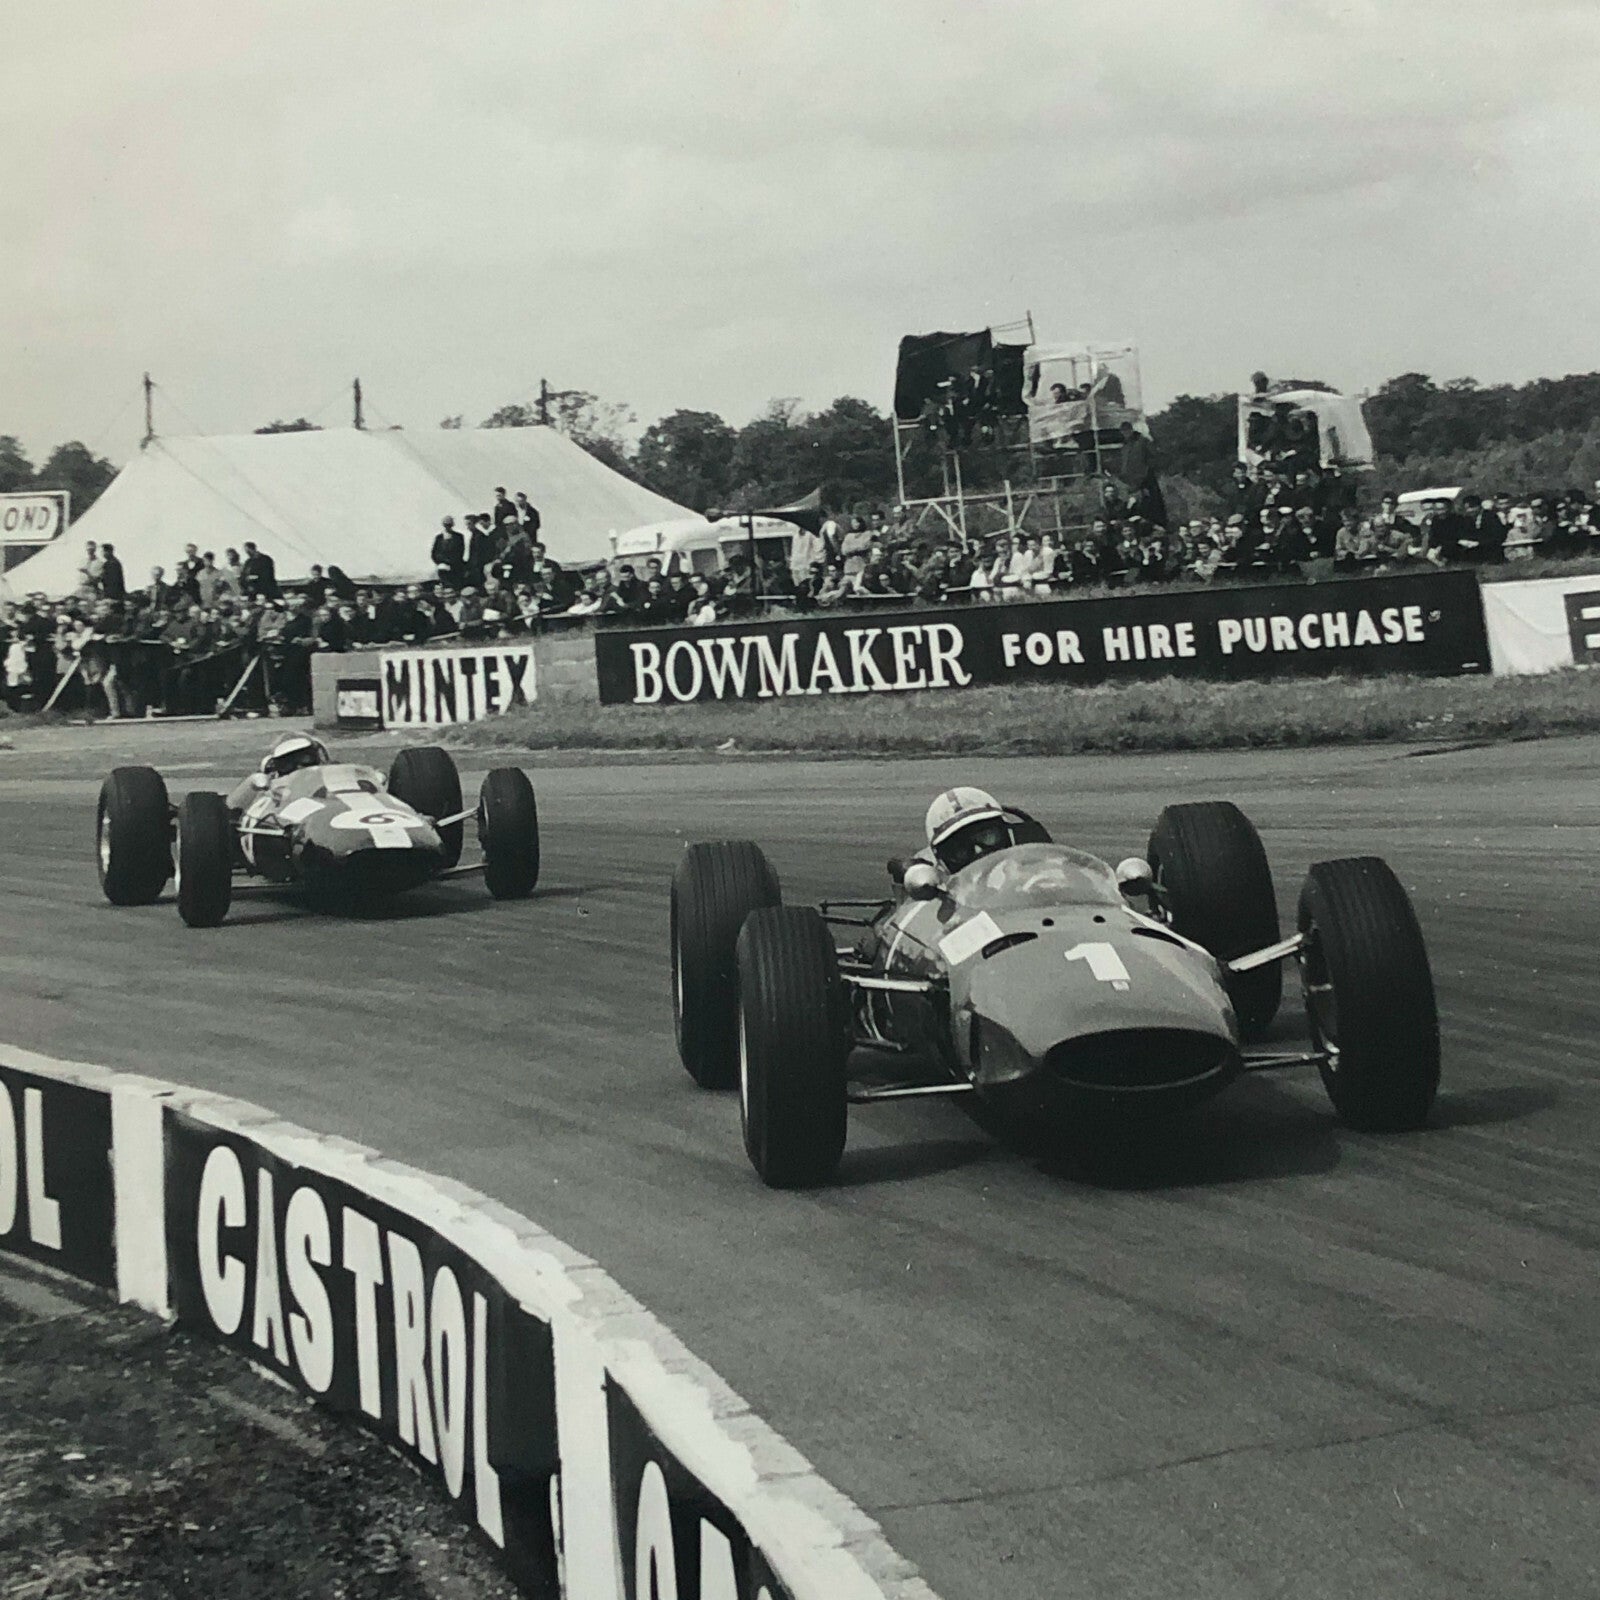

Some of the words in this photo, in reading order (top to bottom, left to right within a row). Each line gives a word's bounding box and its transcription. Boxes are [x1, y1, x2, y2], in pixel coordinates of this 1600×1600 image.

[386, 654, 529, 723] MINTEX
[629, 623, 972, 703] BOWMAKER
[1002, 630, 1085, 667] FOR
[1103, 622, 1196, 661] HIRE
[1218, 605, 1425, 655] PURCHASE
[359, 812, 408, 824] 6
[1063, 942, 1131, 981] 1
[198, 1145, 505, 1549] CASTROL
